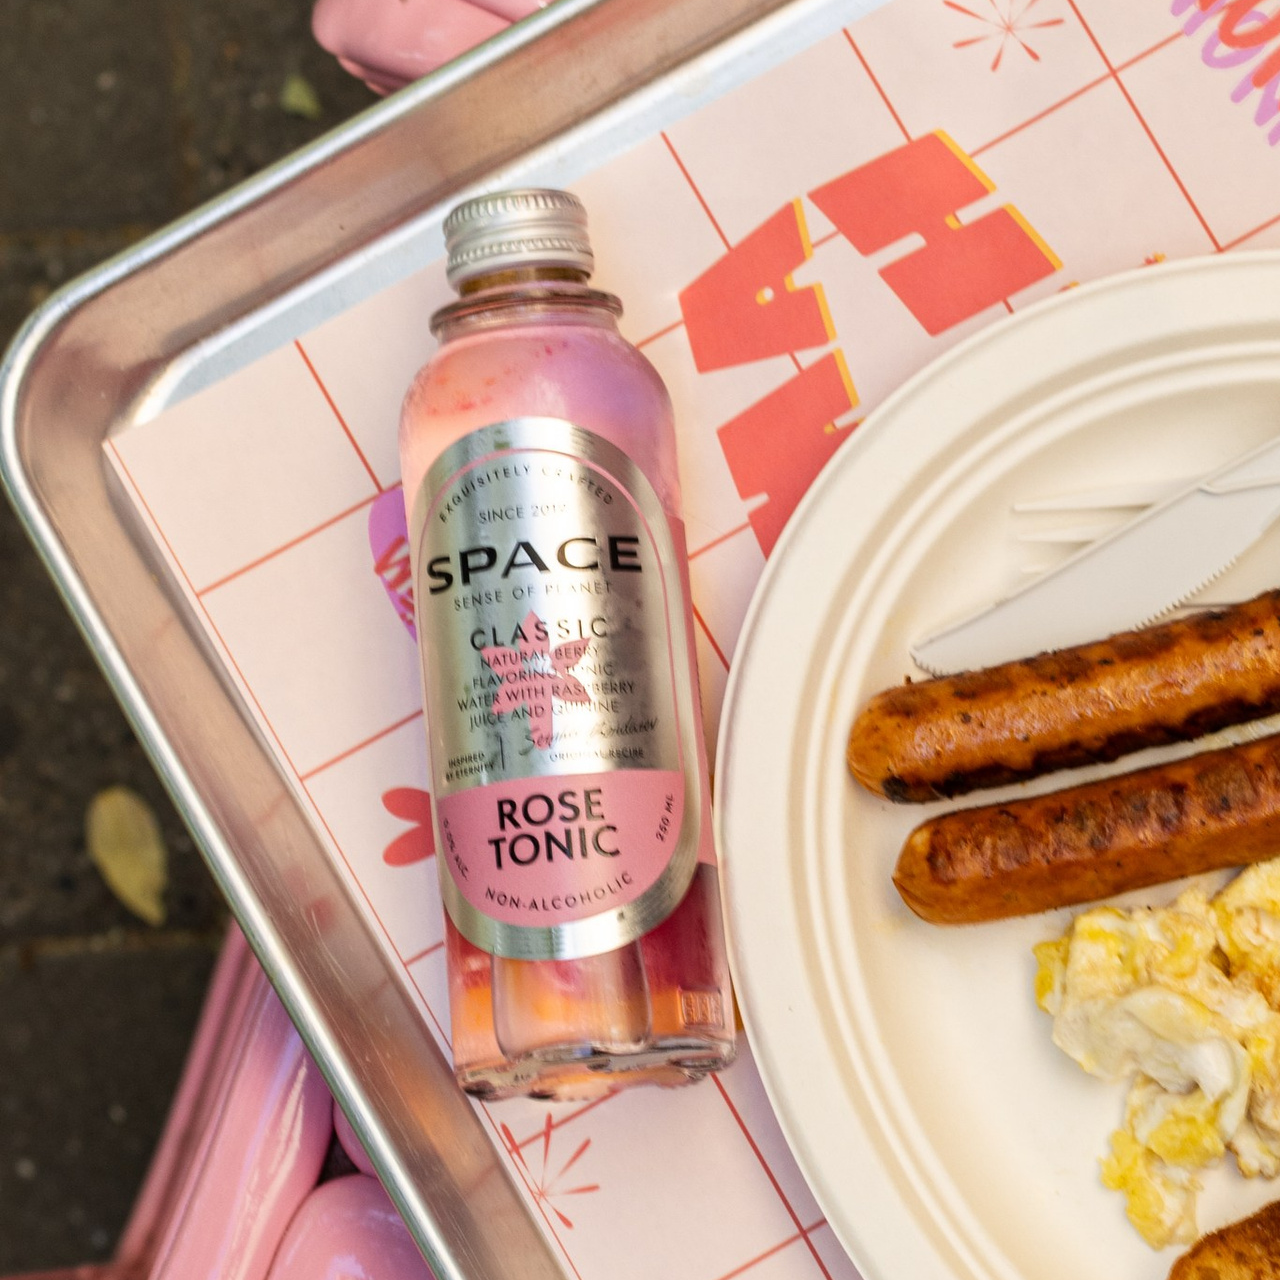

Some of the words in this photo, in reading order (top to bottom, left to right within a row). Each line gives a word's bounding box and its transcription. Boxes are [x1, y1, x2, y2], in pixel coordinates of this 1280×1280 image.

[439, 463, 532, 523] EXQUISITELY
[541, 466, 614, 506] CFTED
[479, 505, 524, 523] SINCE
[426, 535, 643, 596] SPACE
[454, 590, 503, 612] SENSE
[512, 582, 535, 601] OF
[470, 617, 607, 651] CLASSIC
[481, 649, 549, 669] NATURAL
[554, 645, 600, 660] BERRY
[473, 667, 557, 689] FLAVORING
[457, 693, 500, 712] WATER
[506, 686, 545, 702] WITH
[469, 712, 506, 731] JUICE
[510, 704, 545, 720] AND
[551, 700, 621, 716] QUININE
[448, 751, 485, 769] INSPIRED
[455, 760, 495, 779] ETERNITY
[549, 749, 606, 762] ORIGAL
[496, 788, 605, 832] ROSE
[487, 824, 621, 871] TONIC
[485, 871, 634, 912] NON-ALCOHOLIC
